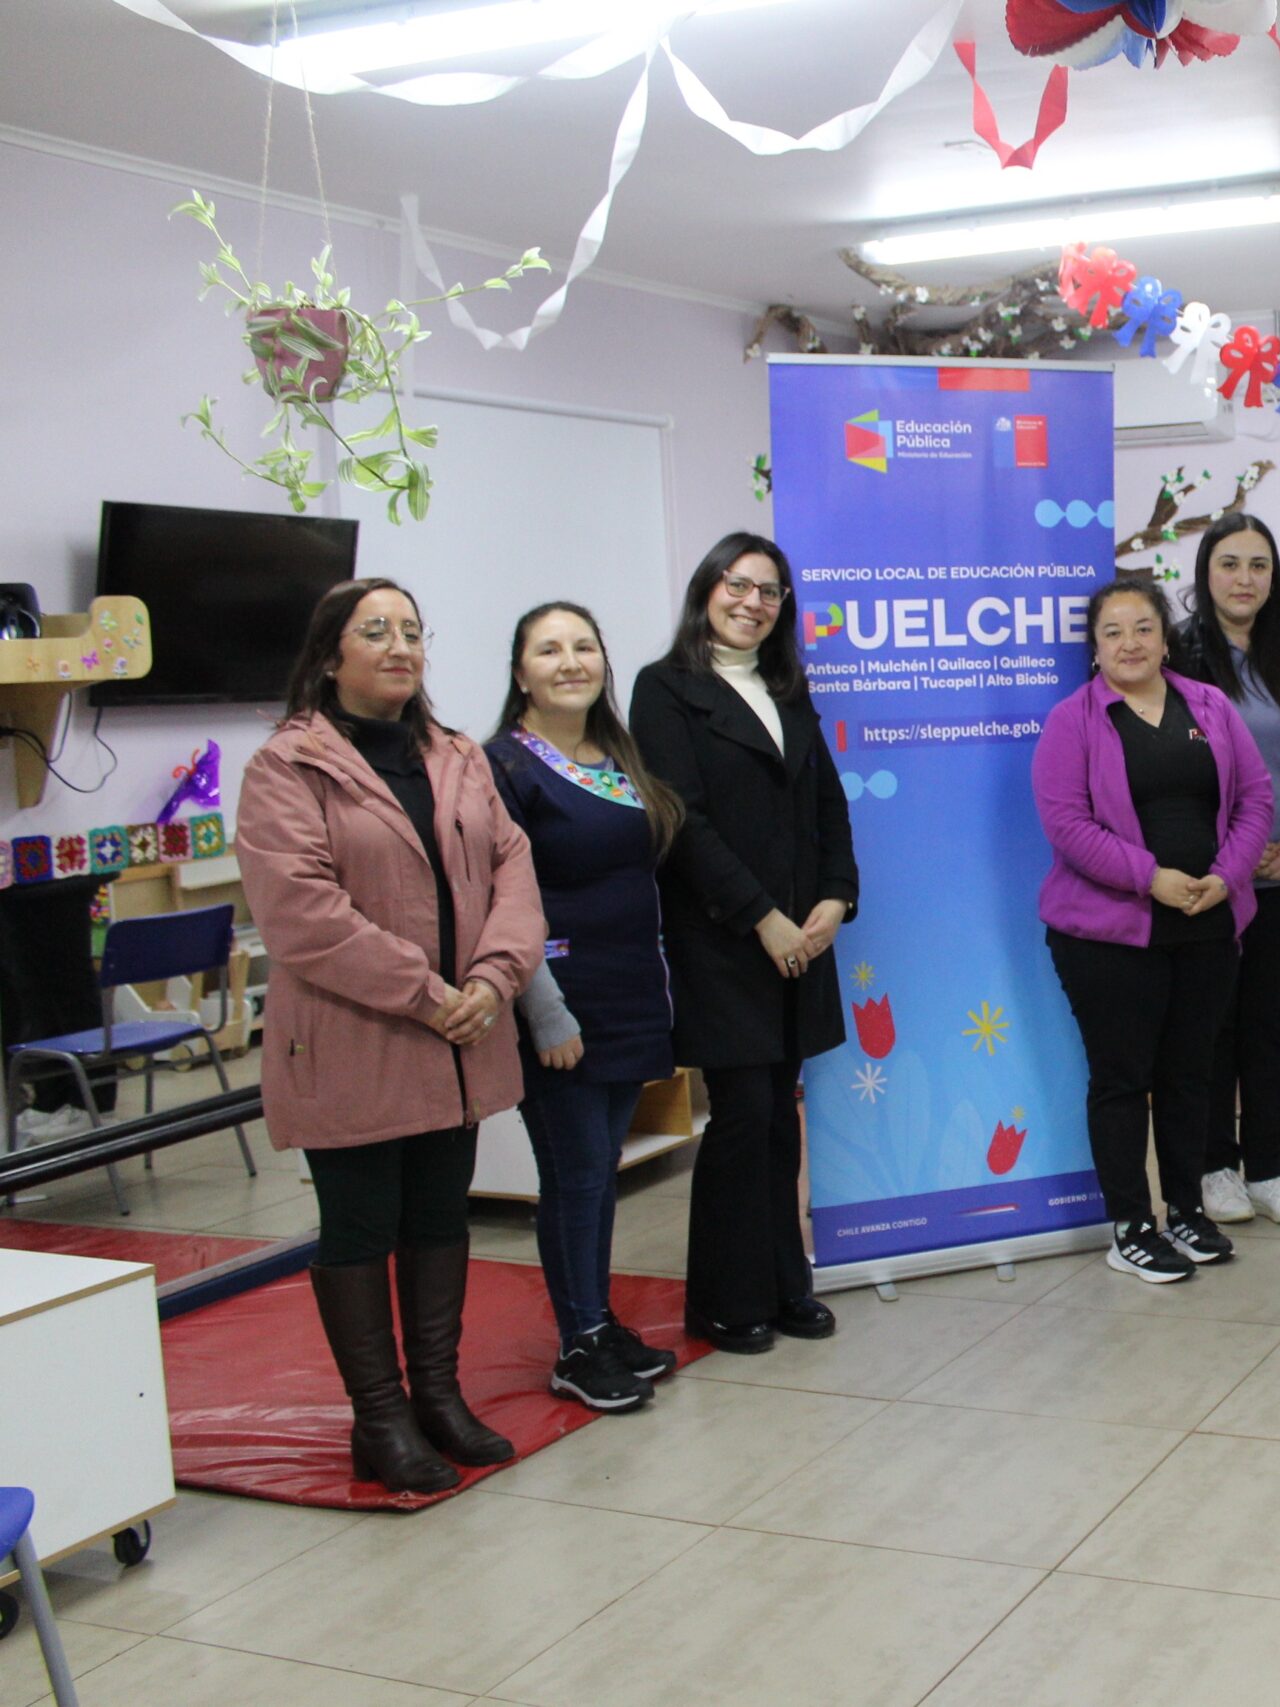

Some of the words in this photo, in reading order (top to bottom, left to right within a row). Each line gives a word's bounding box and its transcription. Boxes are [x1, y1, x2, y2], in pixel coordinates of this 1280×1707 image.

[896, 420, 972, 433] Educación
[896, 434, 951, 448] Pública
[801, 568, 872, 582] SERVICIO
[875, 567, 925, 580] LOCAL
[927, 567, 948, 579] DE
[950, 563, 1035, 579] EDUCACIÓN
[1038, 563, 1096, 577] PÚBLICA
[803, 596, 1090, 650] PUELCHE
[805, 662, 858, 676] Antuco
[867, 659, 928, 674] Mulchén
[937, 657, 992, 671] Quilaco
[1000, 655, 1056, 669] Quilleco
[808, 680, 850, 694] Santa
[853, 678, 911, 692] Bárbara
[920, 674, 977, 691] Tucapel
[986, 673, 1013, 687] Alto
[1015, 671, 1059, 686] Biobío
[1048, 1193, 1087, 1206] GOBIERNO
[837, 1228, 859, 1238] CHILE
[860, 1222, 891, 1234] AVANZA
[892, 1217, 928, 1229] CONTIGO
